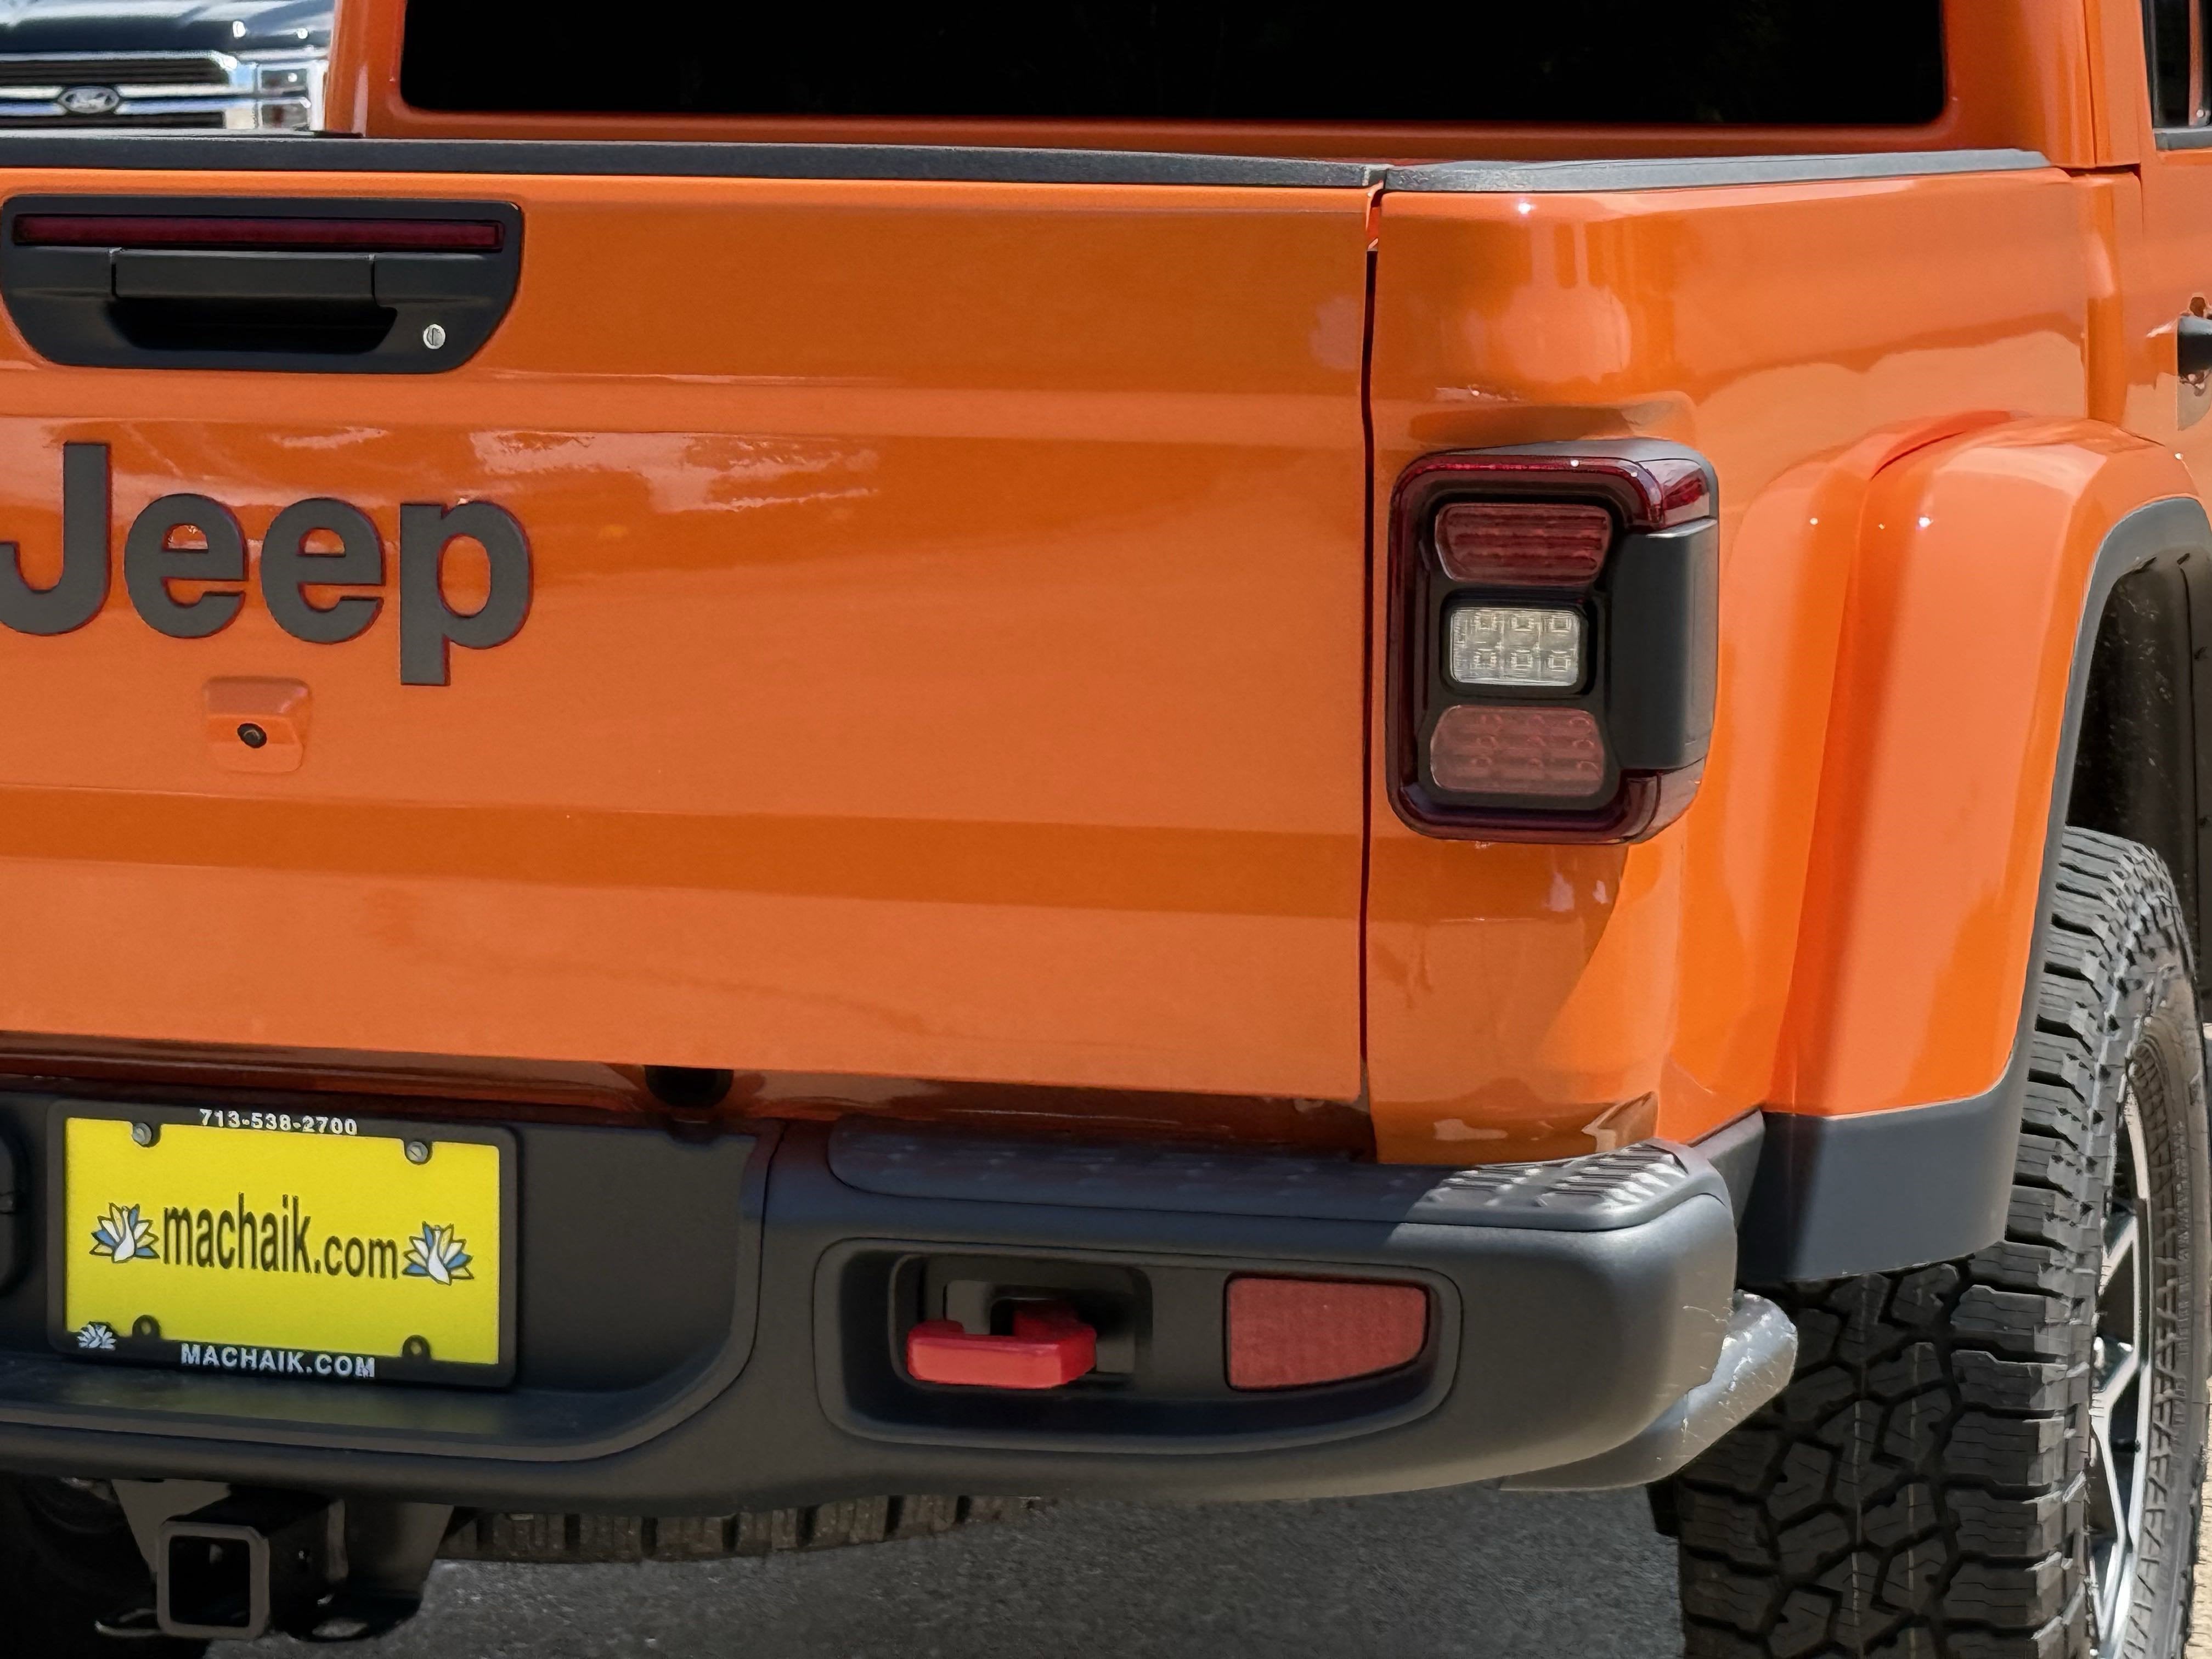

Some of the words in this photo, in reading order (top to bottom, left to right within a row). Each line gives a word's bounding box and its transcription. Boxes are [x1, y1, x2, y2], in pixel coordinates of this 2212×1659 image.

[0, 442, 533, 686] Jeep
[200, 1108, 357, 1135] 713-538-2700
[163, 1192, 398, 1279] machaik.com
[181, 1343, 375, 1378] MACHAIK.COM
